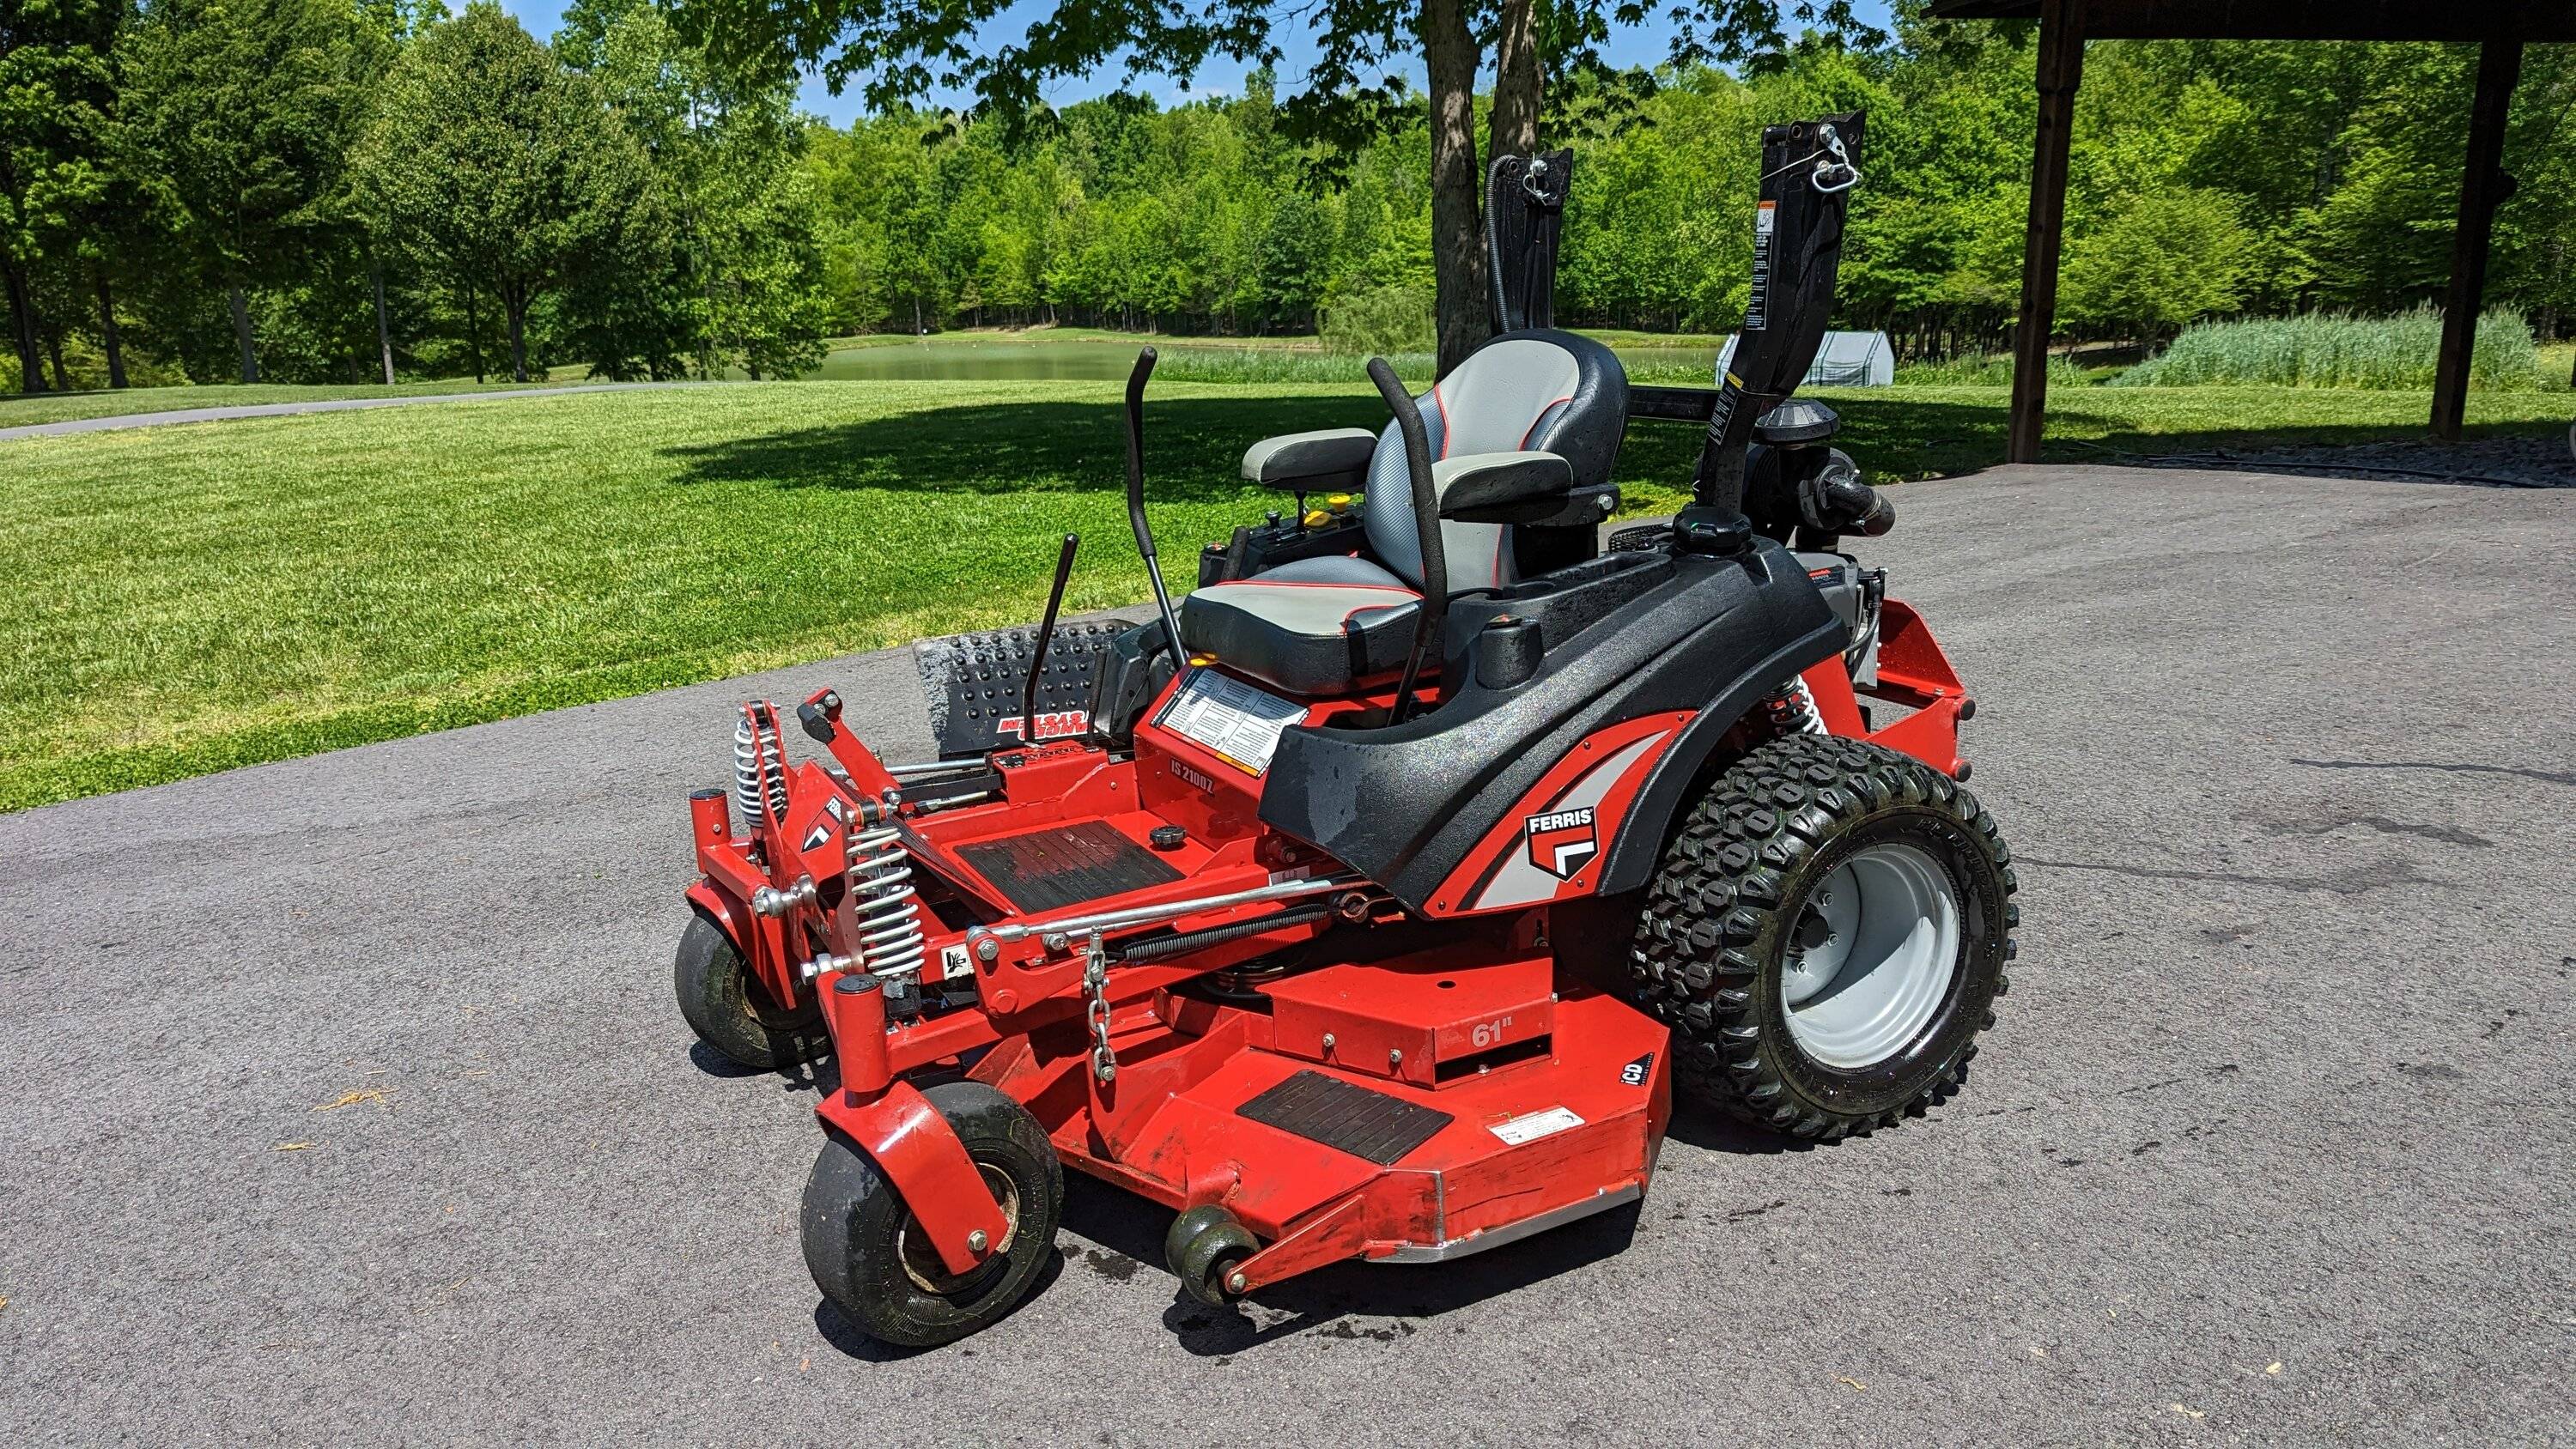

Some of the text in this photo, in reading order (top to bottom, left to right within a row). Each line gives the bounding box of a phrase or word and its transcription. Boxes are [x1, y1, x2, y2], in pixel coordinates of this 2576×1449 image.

[1170, 759, 1214, 794] IS 2100Z
[1529, 809, 1592, 833] FERRIS
[1472, 1016, 1512, 1047] 61"
[1620, 1064, 1643, 1085] iCD
